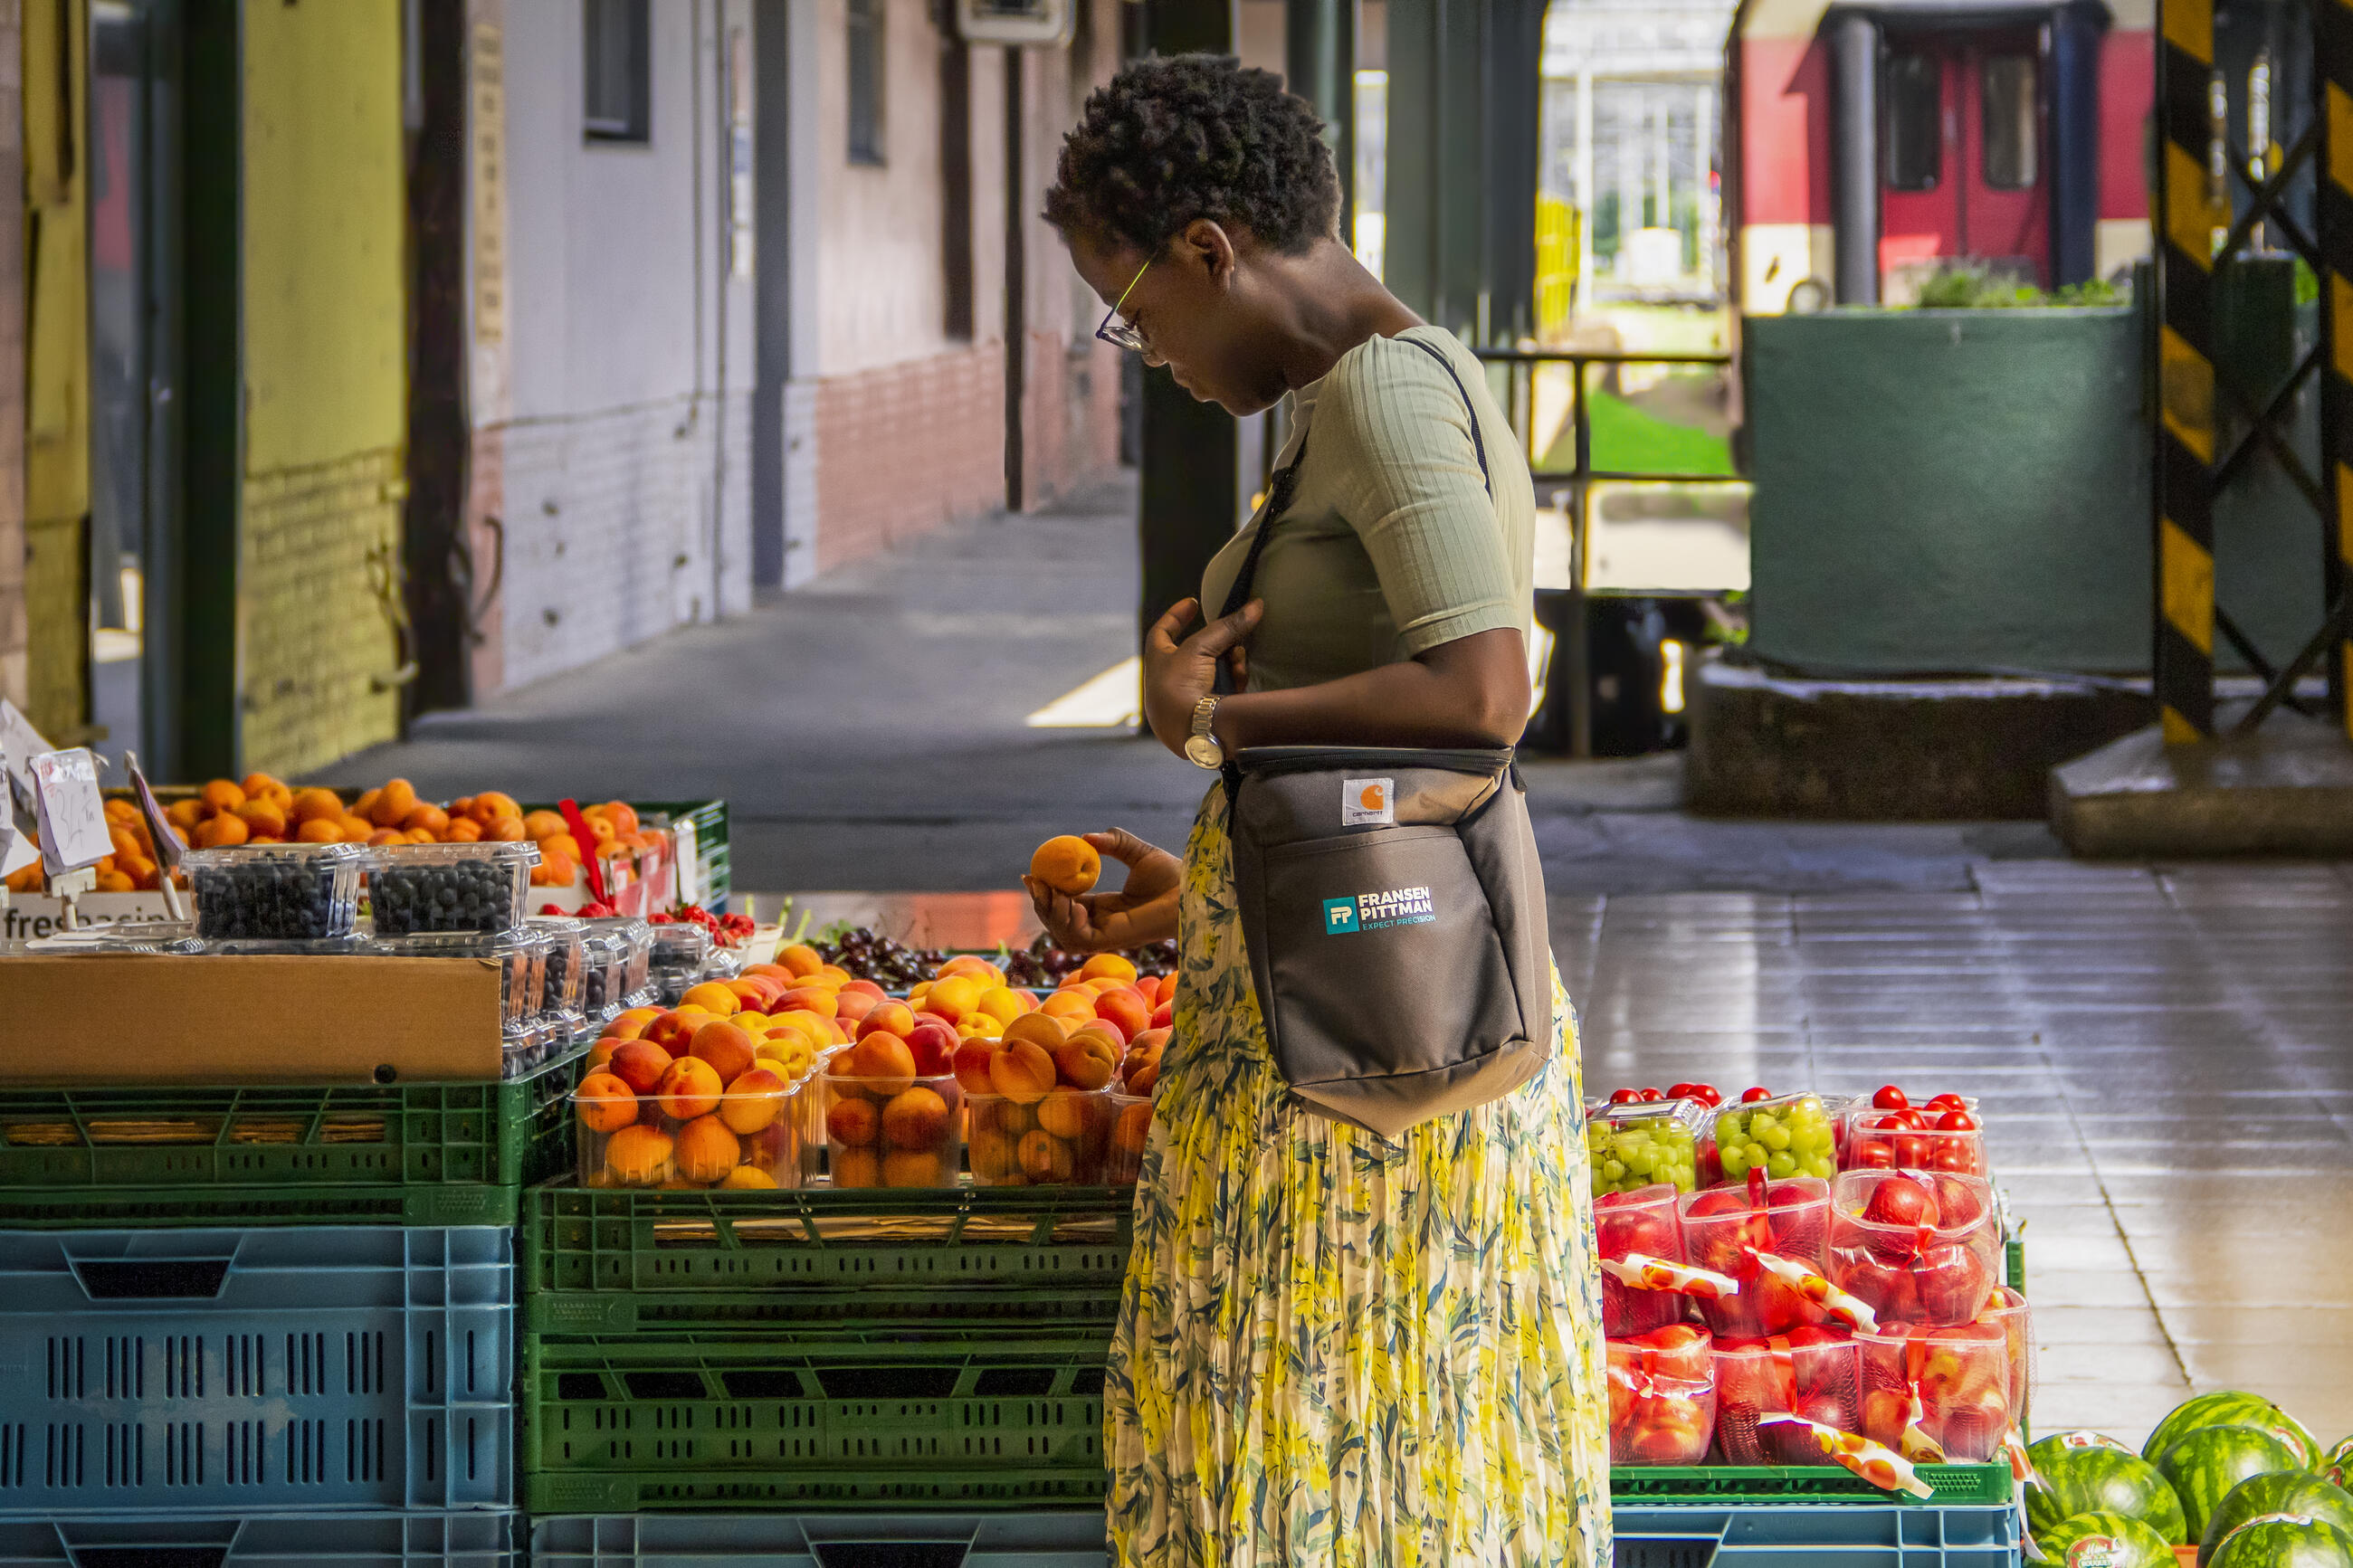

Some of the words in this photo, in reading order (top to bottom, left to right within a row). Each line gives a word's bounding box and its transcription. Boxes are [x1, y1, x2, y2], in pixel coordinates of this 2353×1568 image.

[1358, 887, 1430, 908] FRANSEN
[1360, 899, 1434, 921] PITTMAN
[1362, 920, 1395, 931] EXPECT
[1396, 914, 1436, 927] PRECISION
